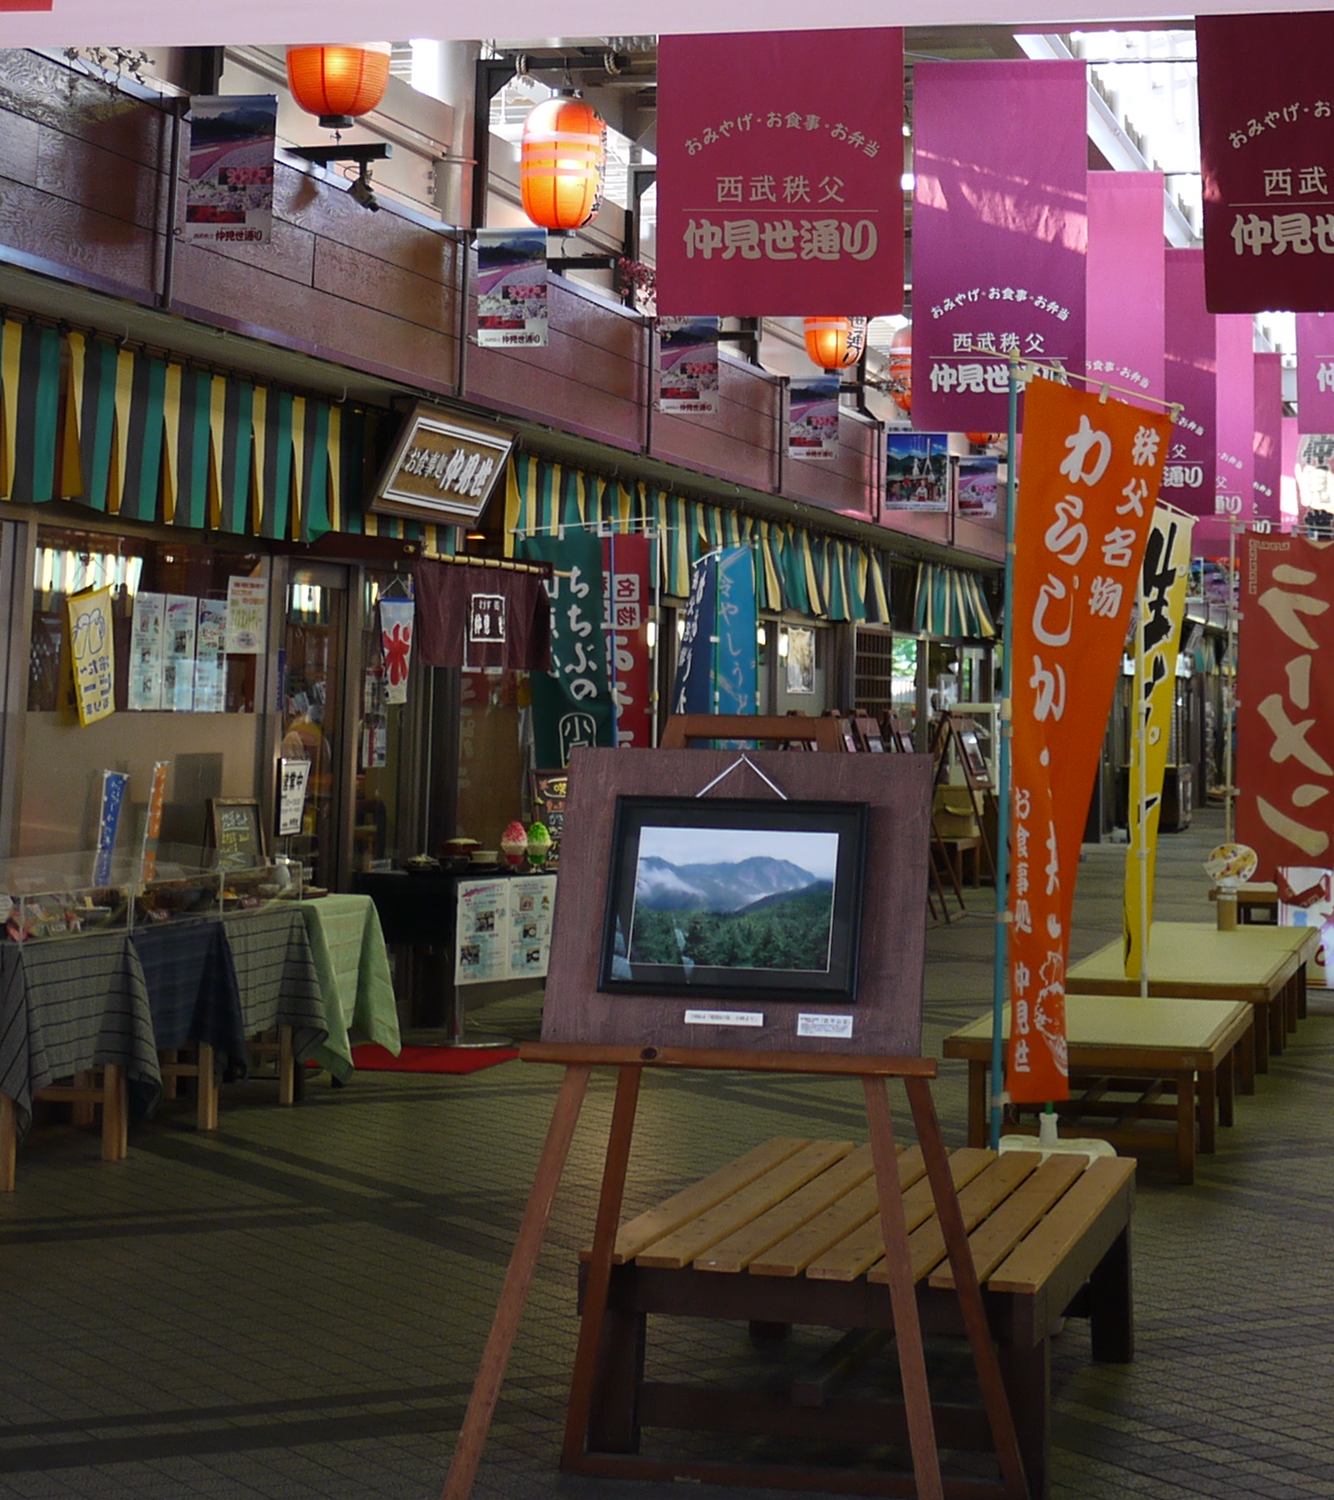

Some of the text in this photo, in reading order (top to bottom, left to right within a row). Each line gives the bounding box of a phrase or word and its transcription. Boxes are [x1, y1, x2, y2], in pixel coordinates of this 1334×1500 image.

[685, 111, 881, 158] おみやげ・お食事・お弁当
[716, 175, 845, 203] 西武秩父
[683, 219, 879, 260] 仲見世通り
[953, 332, 1046, 354] 西武秩父
[1088, 425, 1161, 619] 秩父名物
[383, 622, 411, 687] 氷
[564, 565, 598, 701] ちちぶの
[1257, 563, 1334, 858] ラーメン
